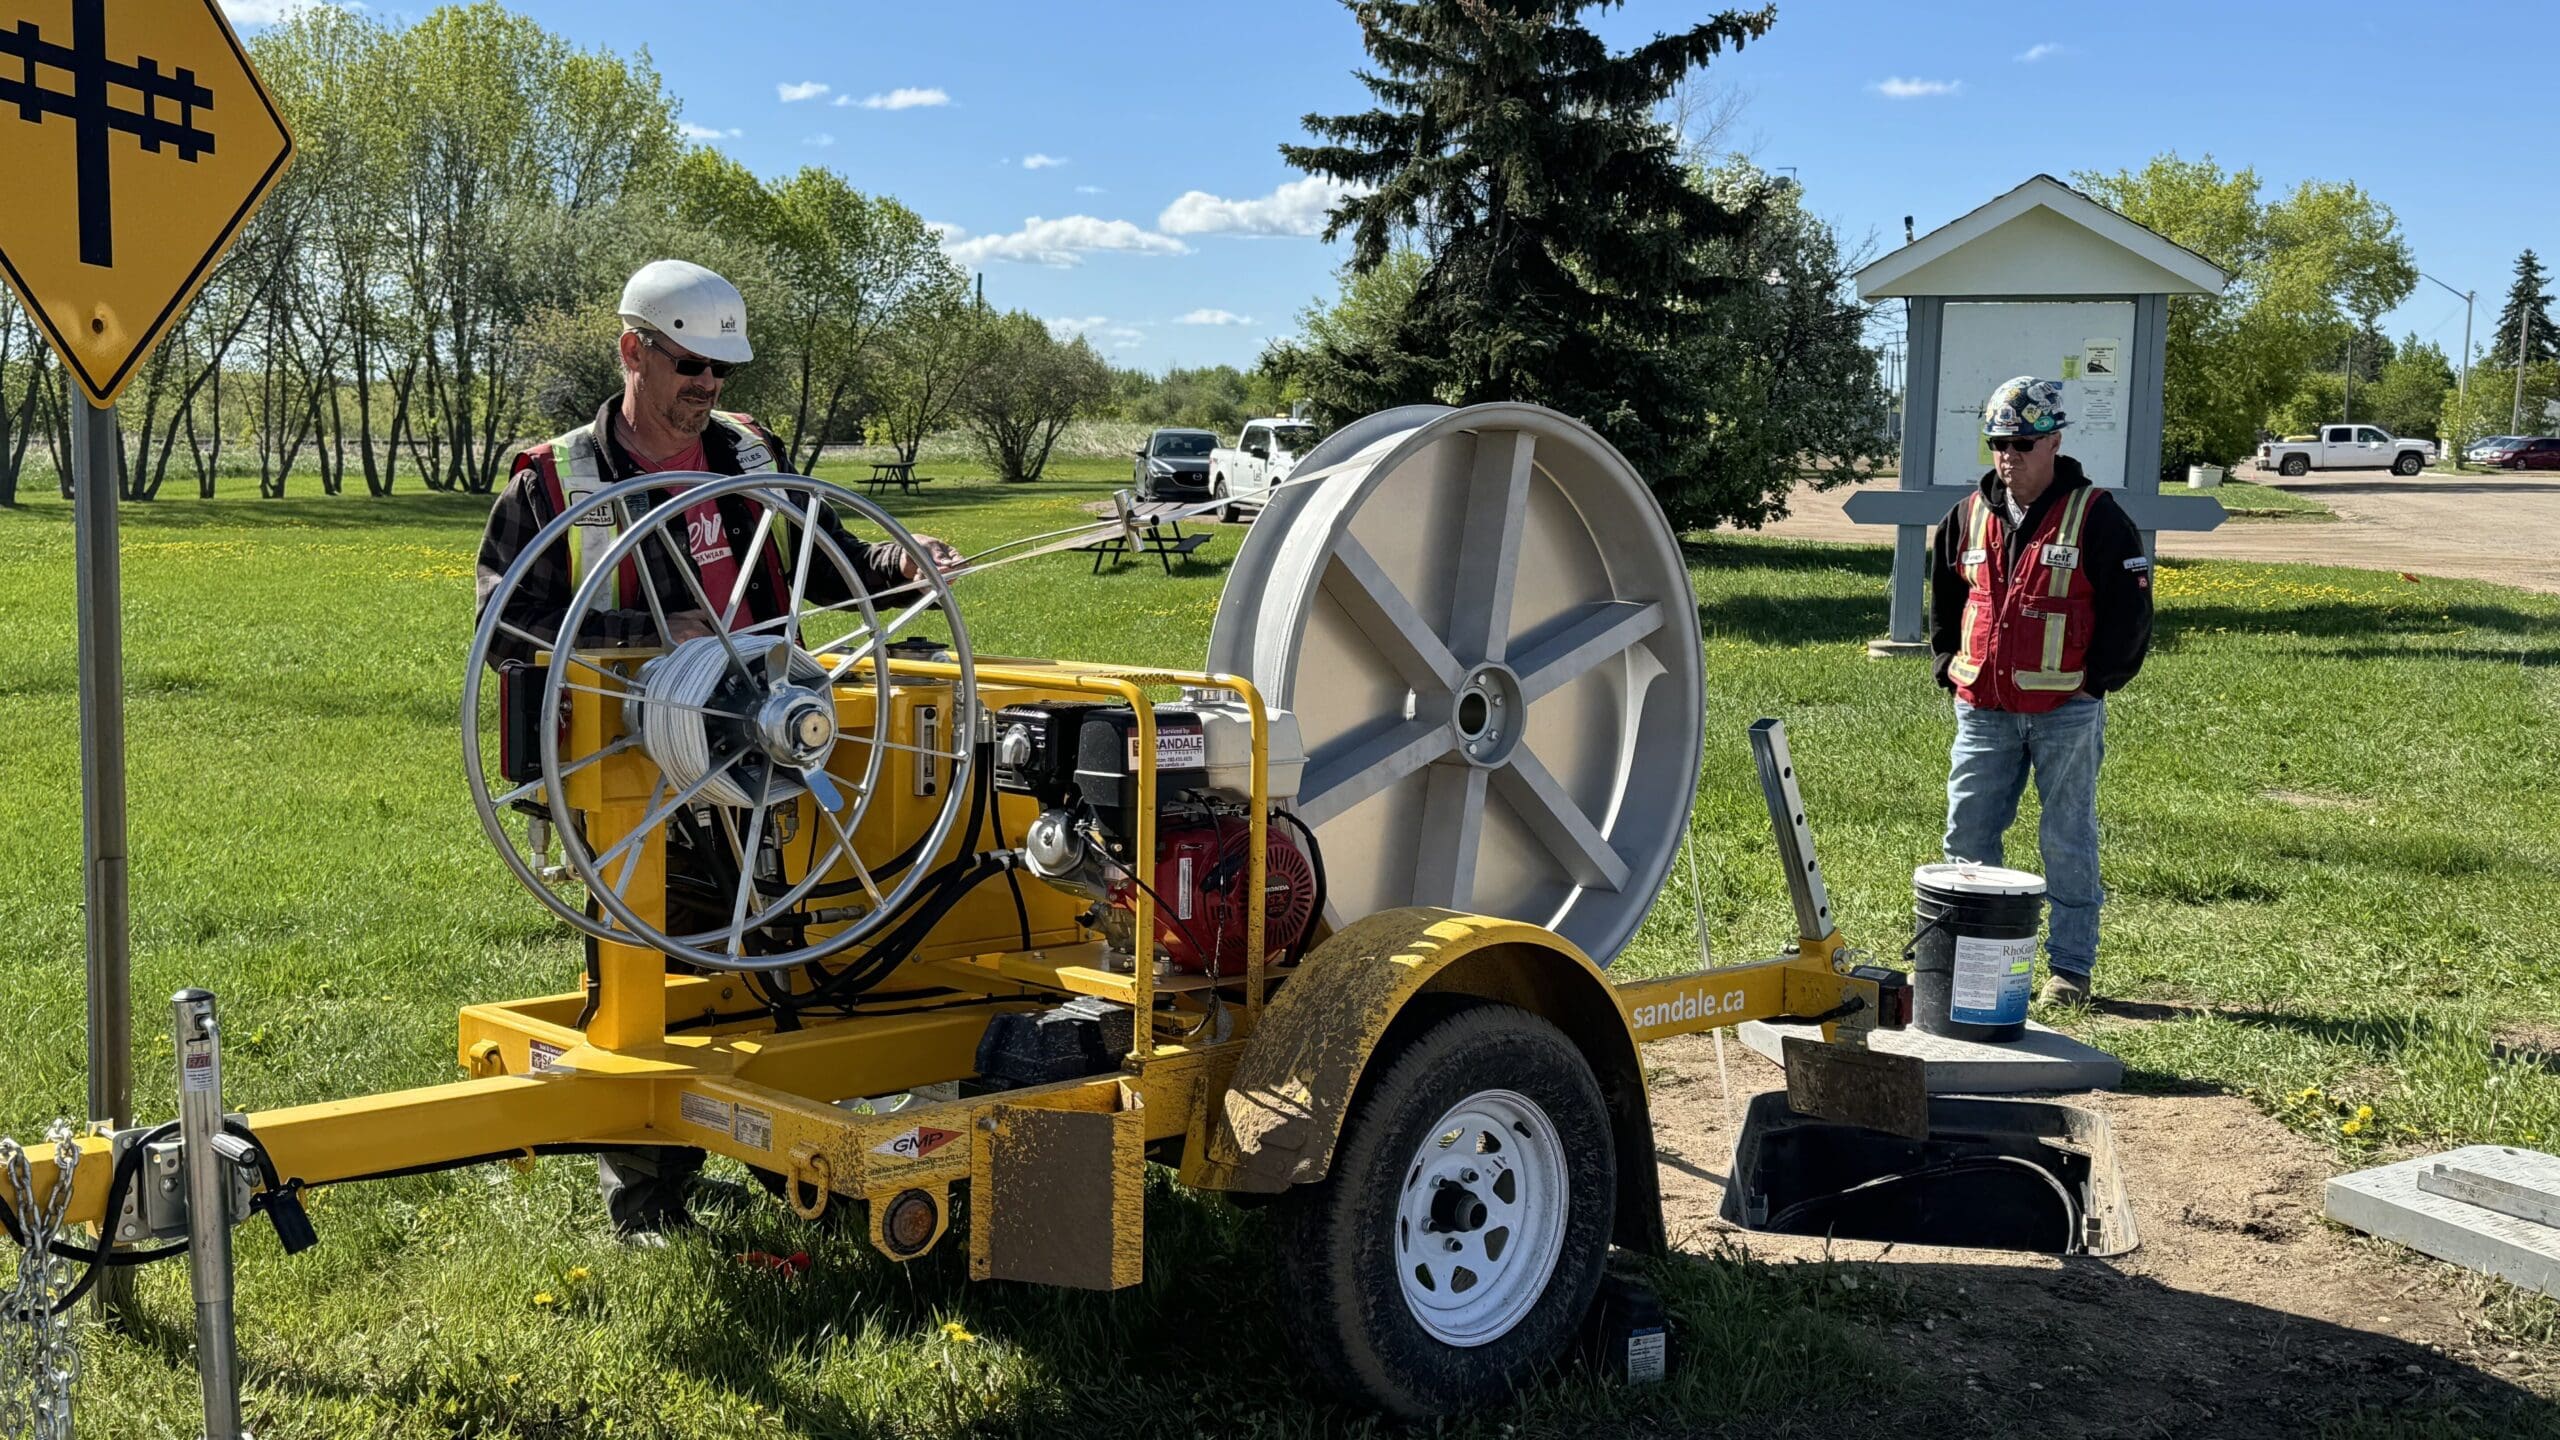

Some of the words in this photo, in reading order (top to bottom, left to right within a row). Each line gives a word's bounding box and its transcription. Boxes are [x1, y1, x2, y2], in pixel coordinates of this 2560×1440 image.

[2047, 550, 2073, 562] Leif
[1632, 988, 1745, 1029] sandale.ca
[893, 1132, 943, 1153] GMP
